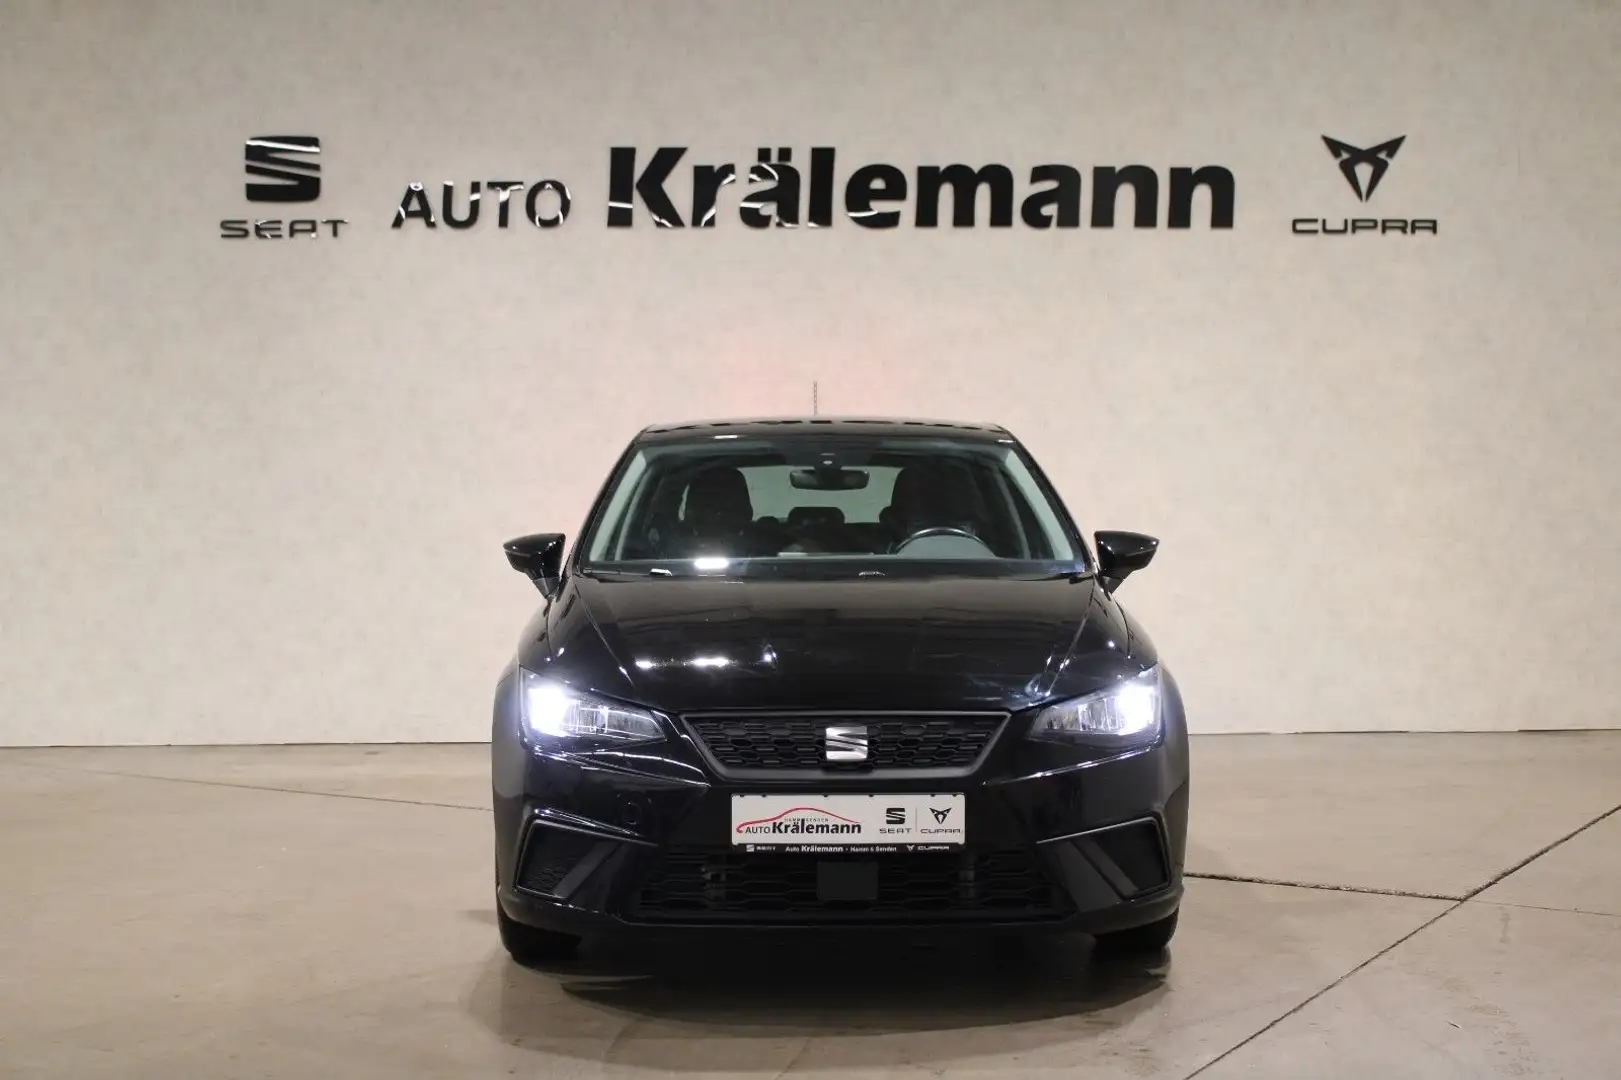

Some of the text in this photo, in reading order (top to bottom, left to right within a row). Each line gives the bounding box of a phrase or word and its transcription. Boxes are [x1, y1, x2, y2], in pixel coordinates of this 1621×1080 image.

[391, 146, 1235, 230] AUTO Krälemann
[219, 219, 348, 239] SEAT
[1292, 218, 1438, 235] CUPRA
[744, 818, 862, 835] AUTO Krälemann
[785, 845, 800, 853] Auto
[801, 845, 844, 853] Krälemann
